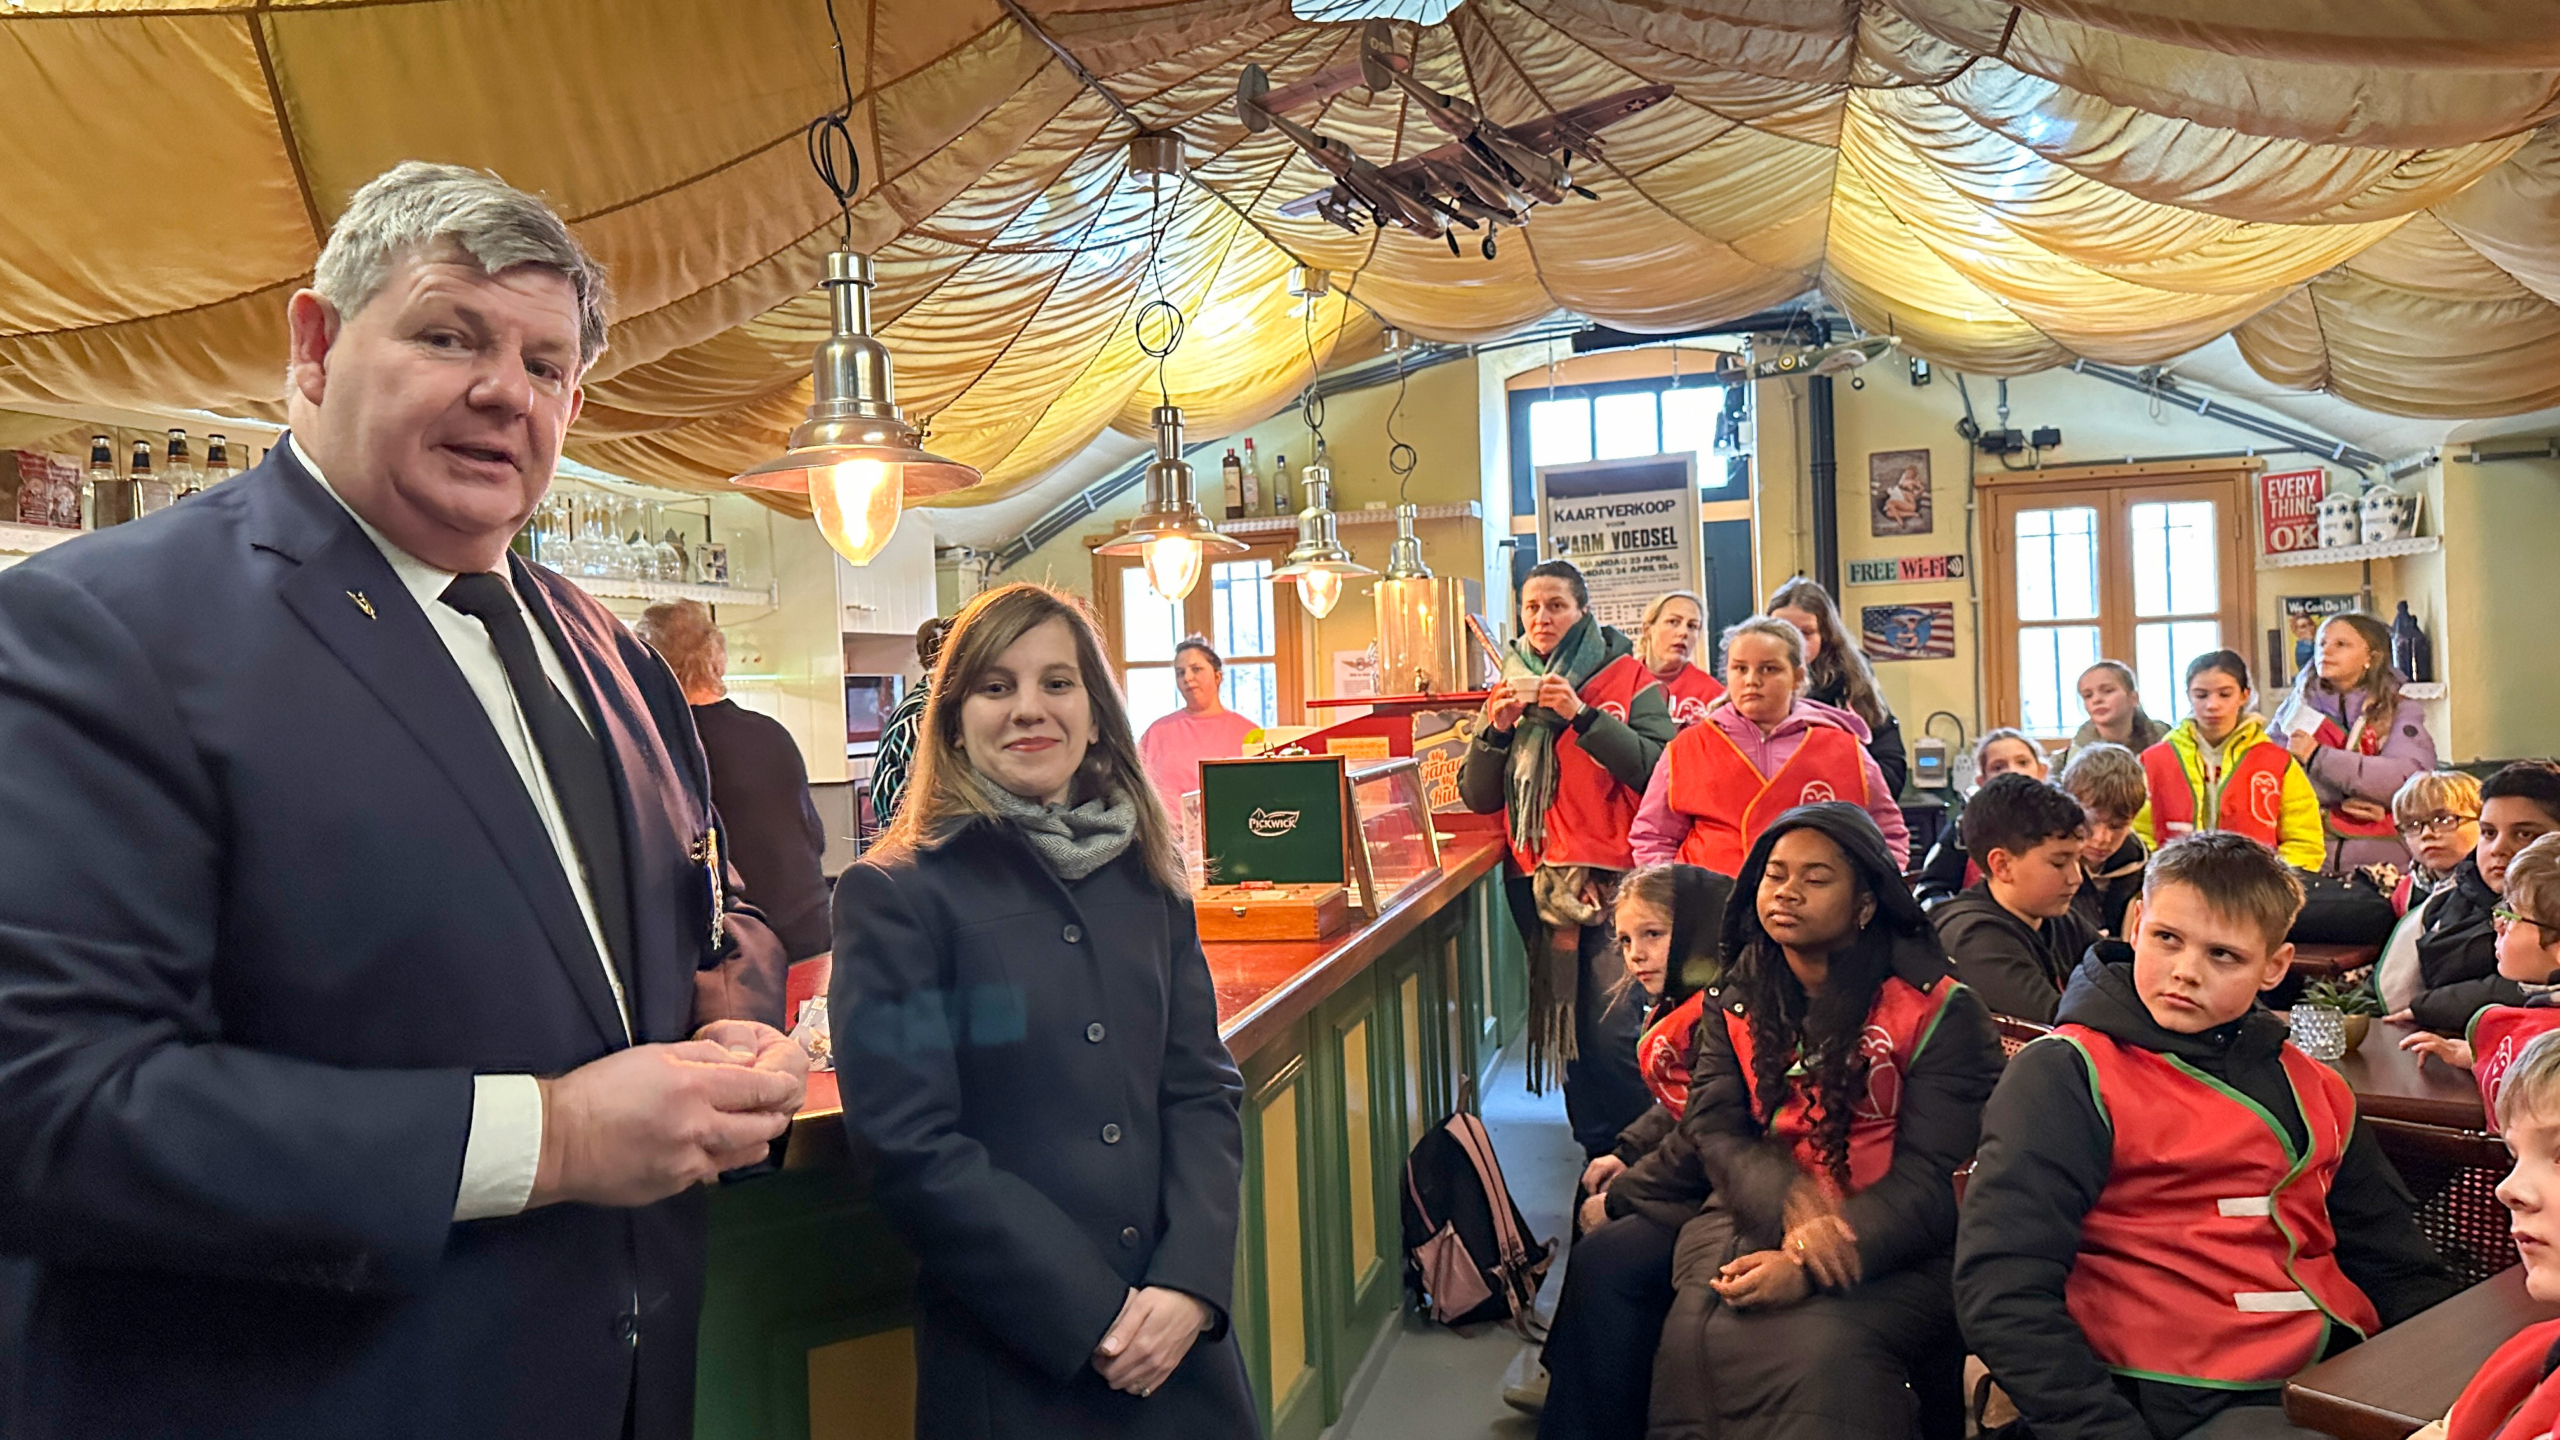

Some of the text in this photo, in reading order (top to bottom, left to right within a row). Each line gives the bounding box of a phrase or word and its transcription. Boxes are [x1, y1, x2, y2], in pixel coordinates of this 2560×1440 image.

[2268, 475, 2316, 499] EVERY
[1555, 499, 1675, 522] KAARTVERKOOP
[2270, 495, 2316, 519] THING
[1556, 526, 1677, 554] WARM VOEDSEL
[2270, 524, 2318, 551] OK
[1630, 564, 1655, 573] APRIL
[1643, 554, 1668, 563] APRIL
[1850, 556, 1945, 582] FREE Wi-Fi
[2304, 600, 2324, 613] Can
[2324, 600, 2339, 612] Do
[1249, 818, 1297, 829] PICKWICK
